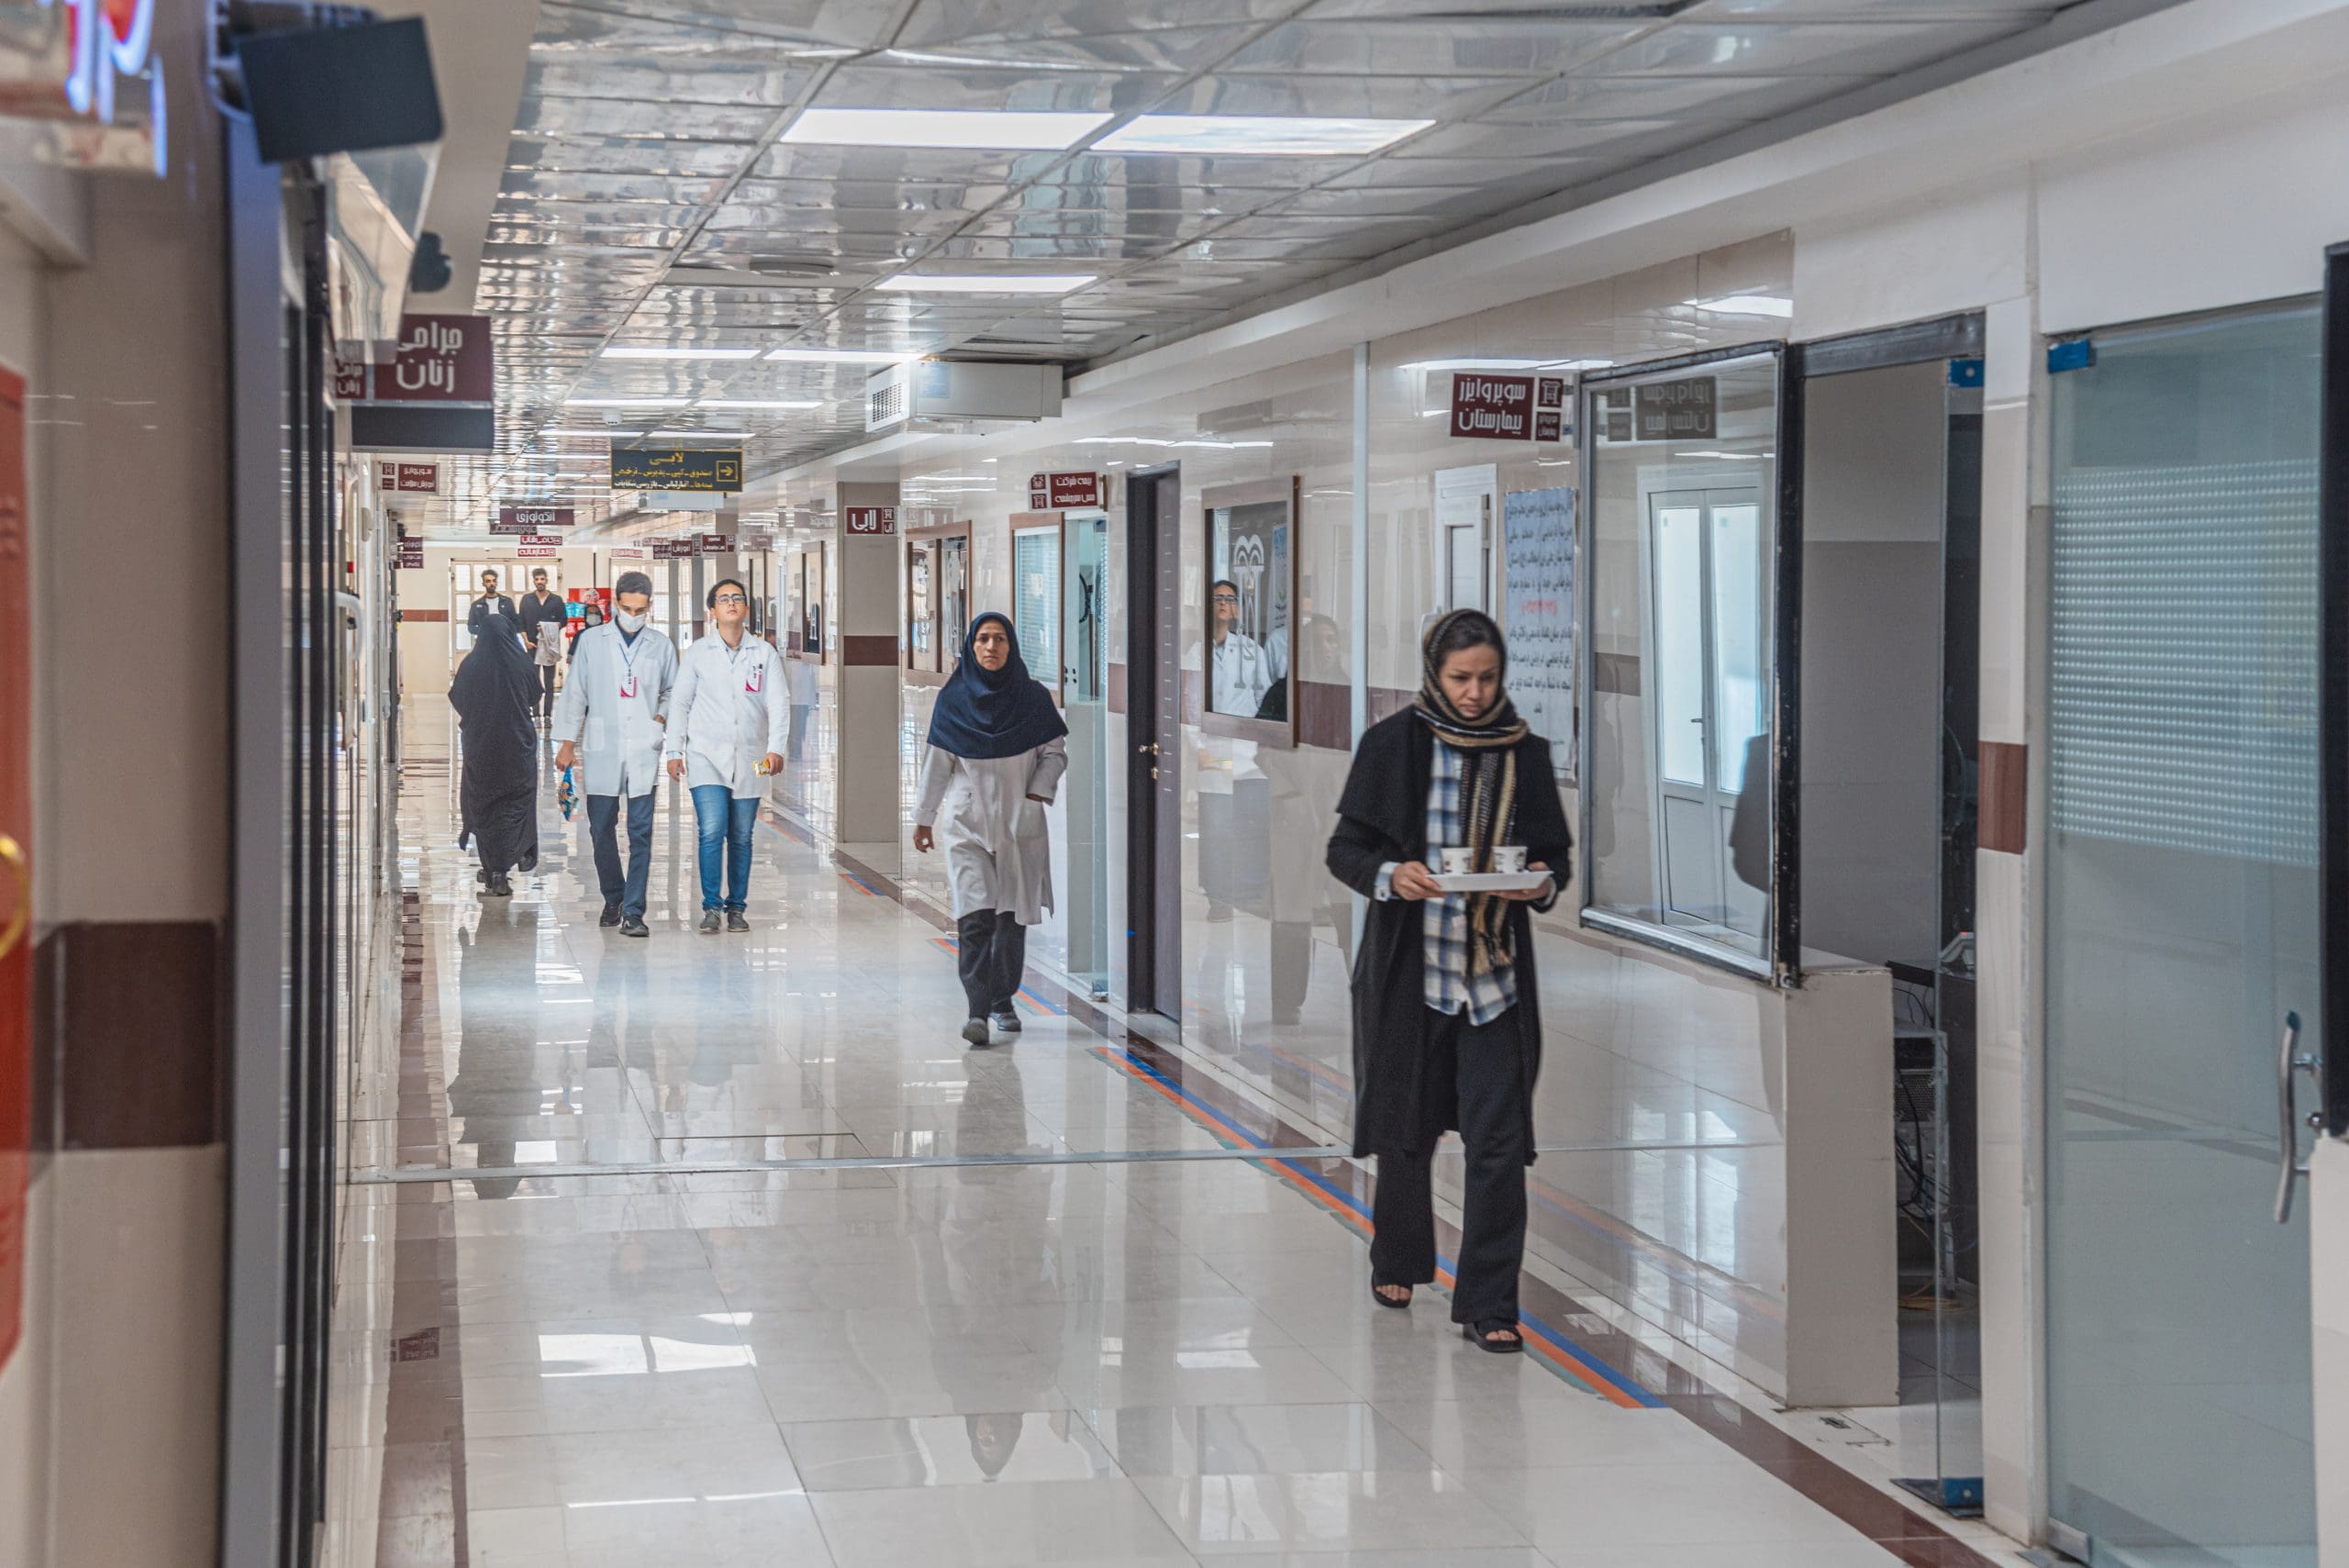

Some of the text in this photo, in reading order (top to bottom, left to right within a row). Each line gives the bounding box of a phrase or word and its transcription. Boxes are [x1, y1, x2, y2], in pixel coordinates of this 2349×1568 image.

[396, 321, 463, 356] جراحی
[395, 358, 456, 394] زنان
[1458, 377, 1527, 406] سوپروایزر
[1458, 407, 1523, 435] بیمارستان
[649, 451, 685, 466] لابی
[516, 510, 556, 524] آنکولوژی
[852, 509, 877, 532] لابی
